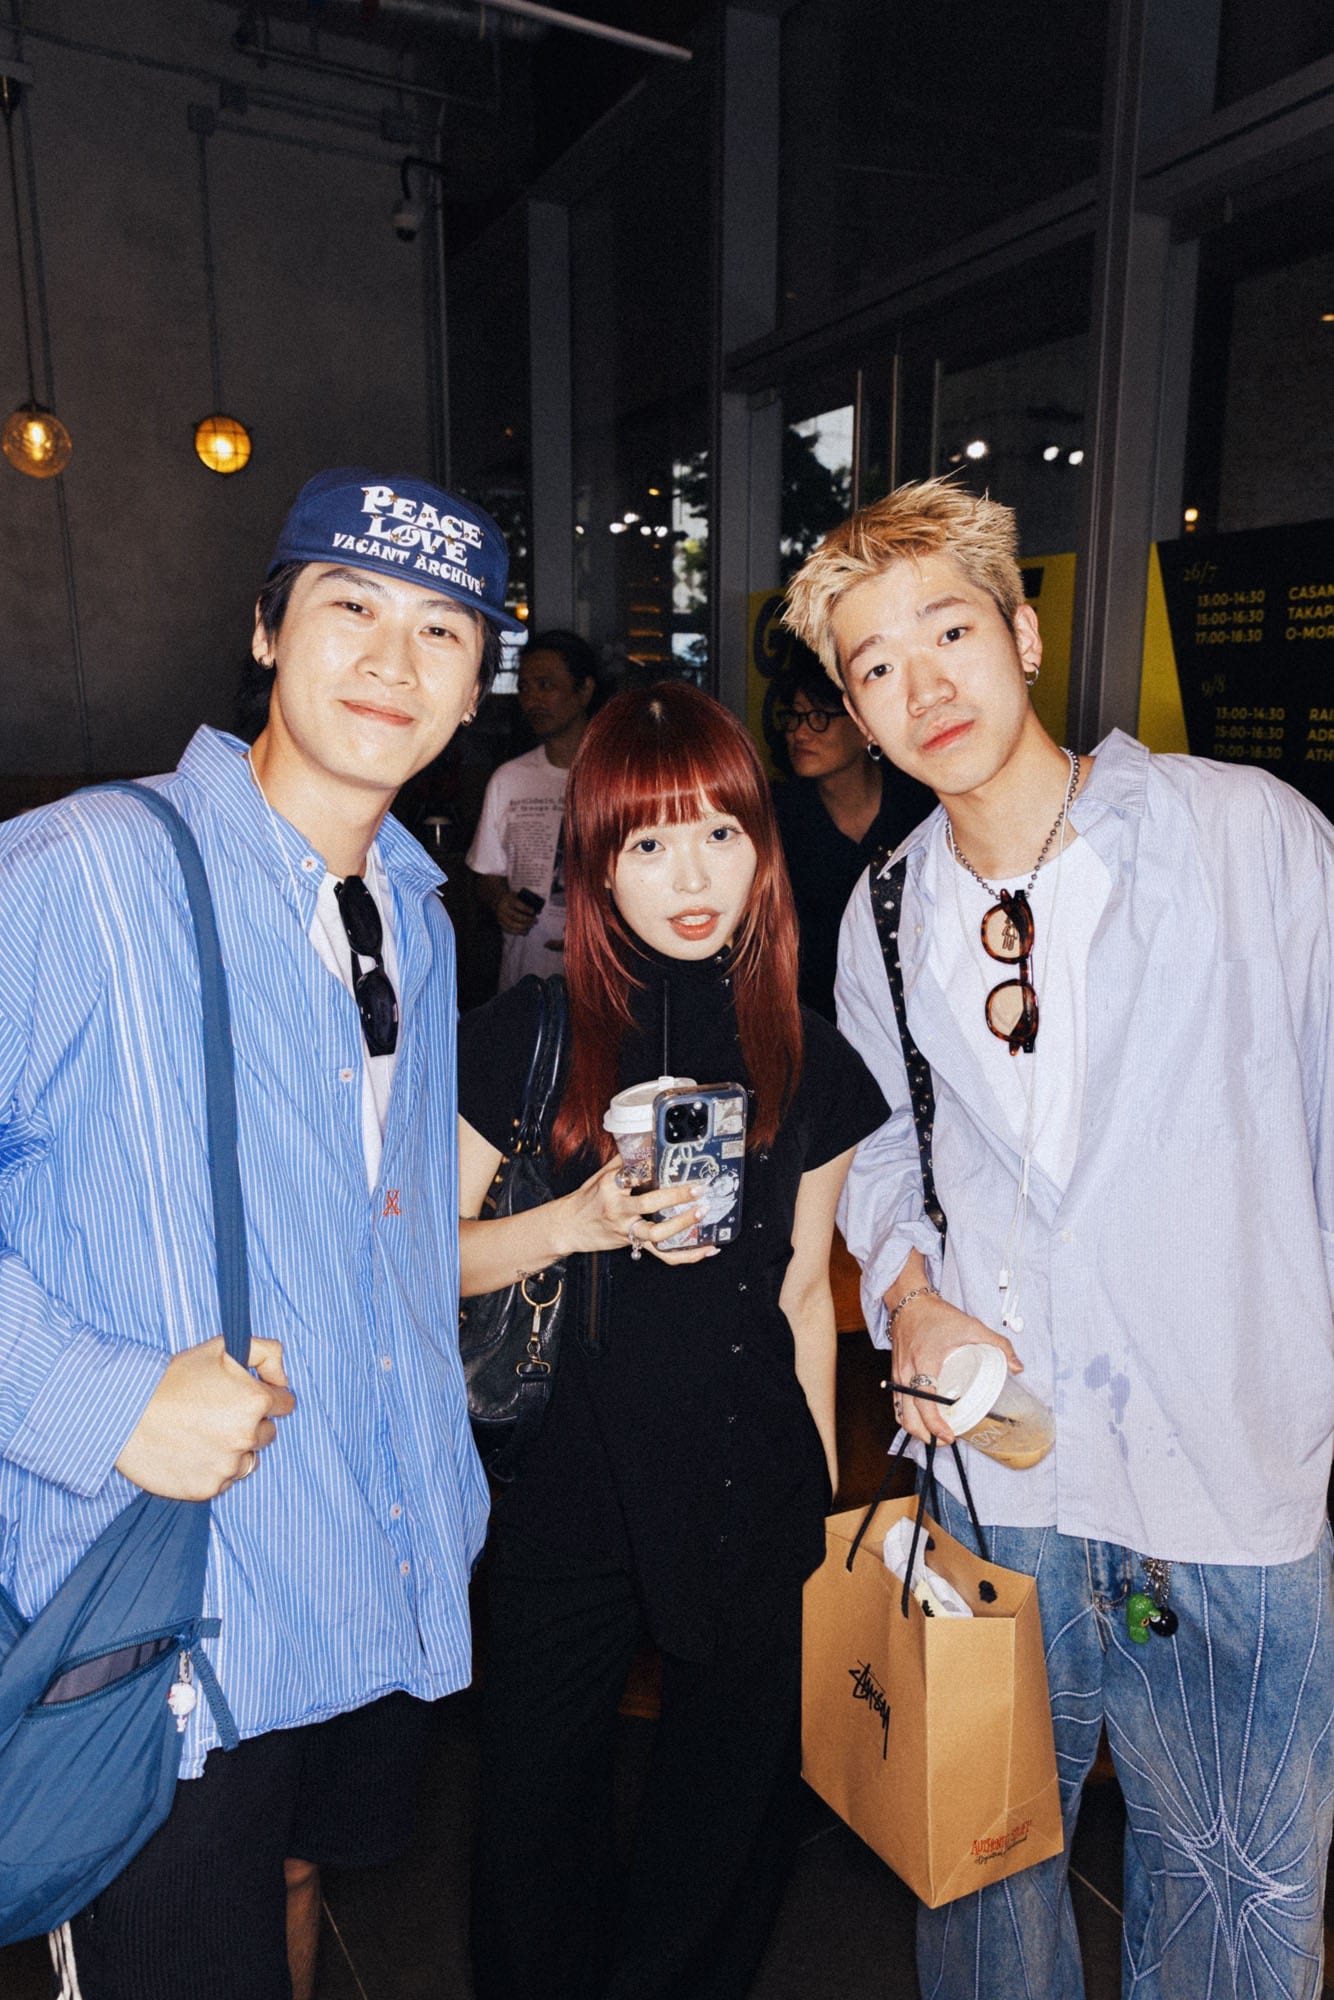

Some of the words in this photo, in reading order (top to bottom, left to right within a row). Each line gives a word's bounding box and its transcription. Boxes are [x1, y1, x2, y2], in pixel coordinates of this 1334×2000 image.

[360, 486, 482, 549] PEACE
[365, 514, 468, 567] LOVE
[331, 532, 411, 566] VACANT
[413, 554, 483, 597] ARCHIVE
